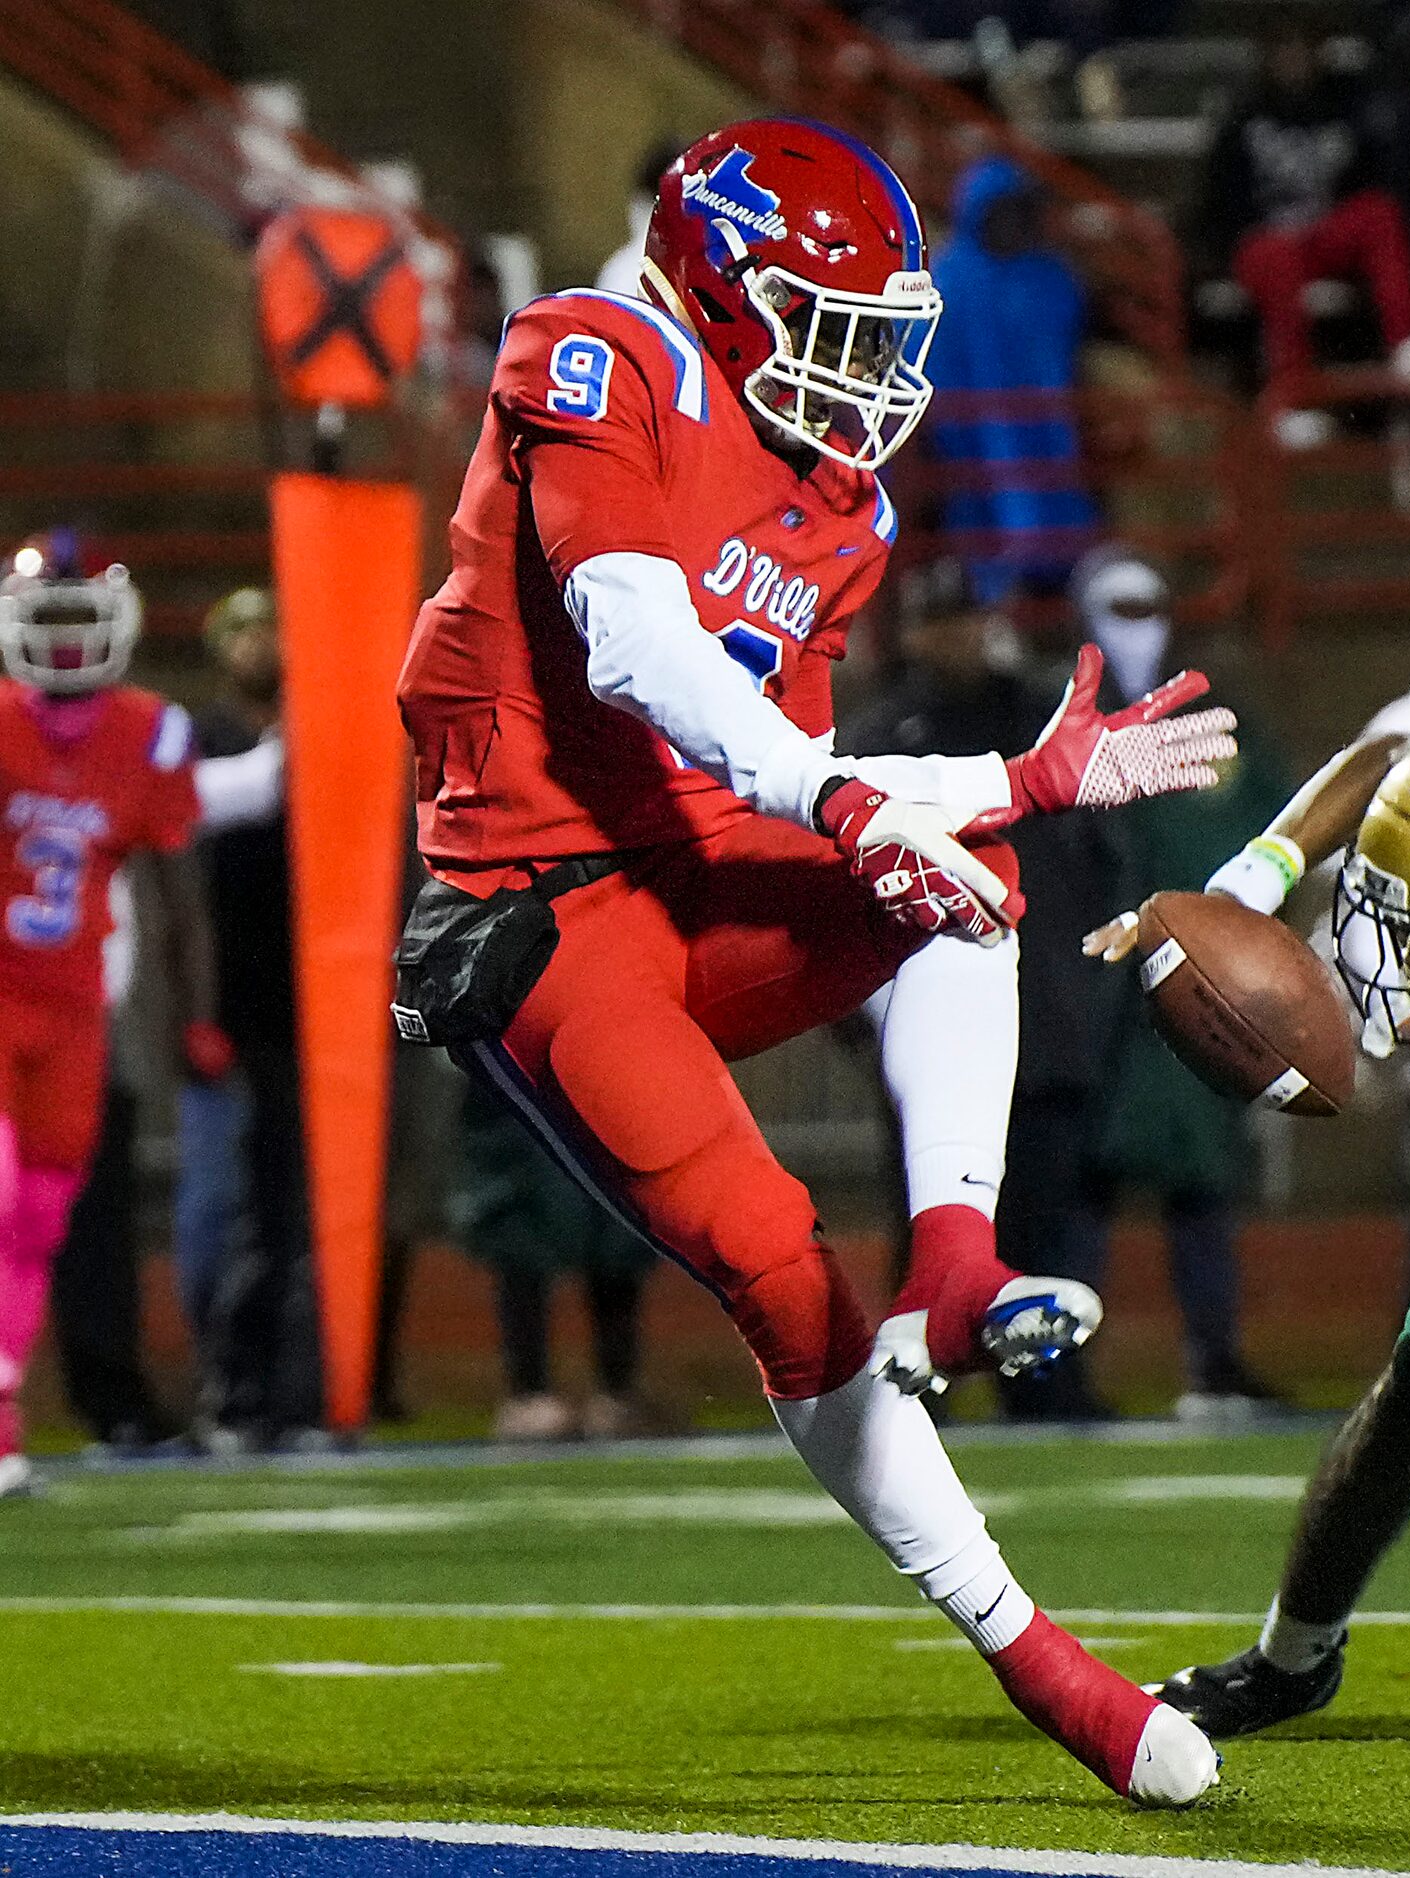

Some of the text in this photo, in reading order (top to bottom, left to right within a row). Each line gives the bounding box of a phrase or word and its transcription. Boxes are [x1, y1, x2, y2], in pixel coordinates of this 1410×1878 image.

[681, 168, 788, 241] Duncanville
[546, 332, 615, 421] 9
[5, 825, 86, 948] 3
